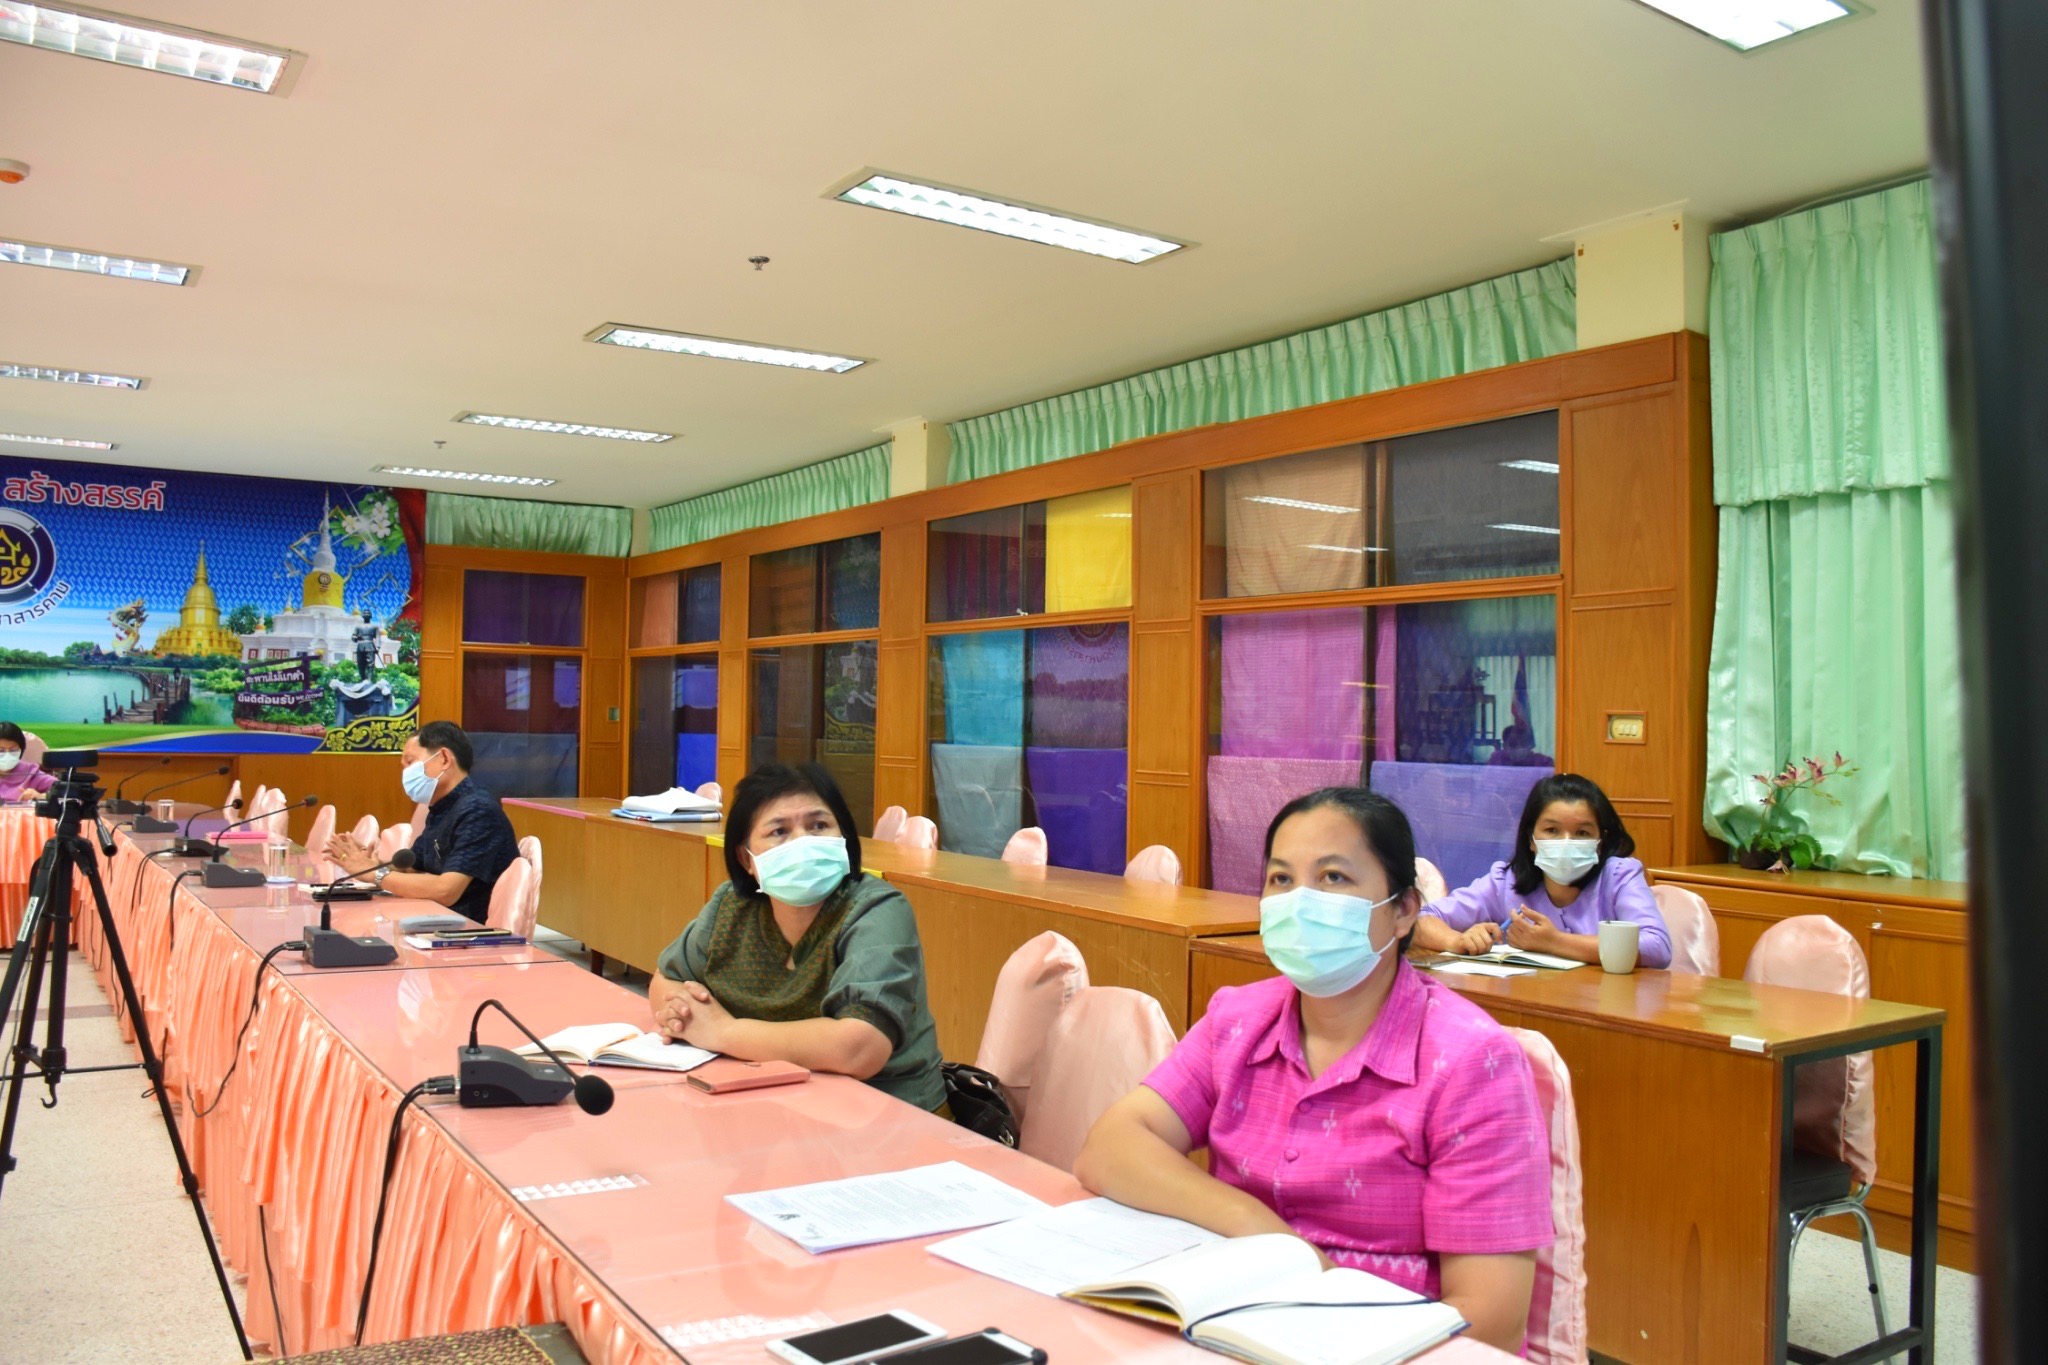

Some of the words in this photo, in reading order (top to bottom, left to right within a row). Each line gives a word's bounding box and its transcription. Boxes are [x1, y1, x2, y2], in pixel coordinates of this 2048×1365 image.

[4, 471, 167, 511] สร้างสรรค์
[0, 580, 70, 626] าสารคาม
